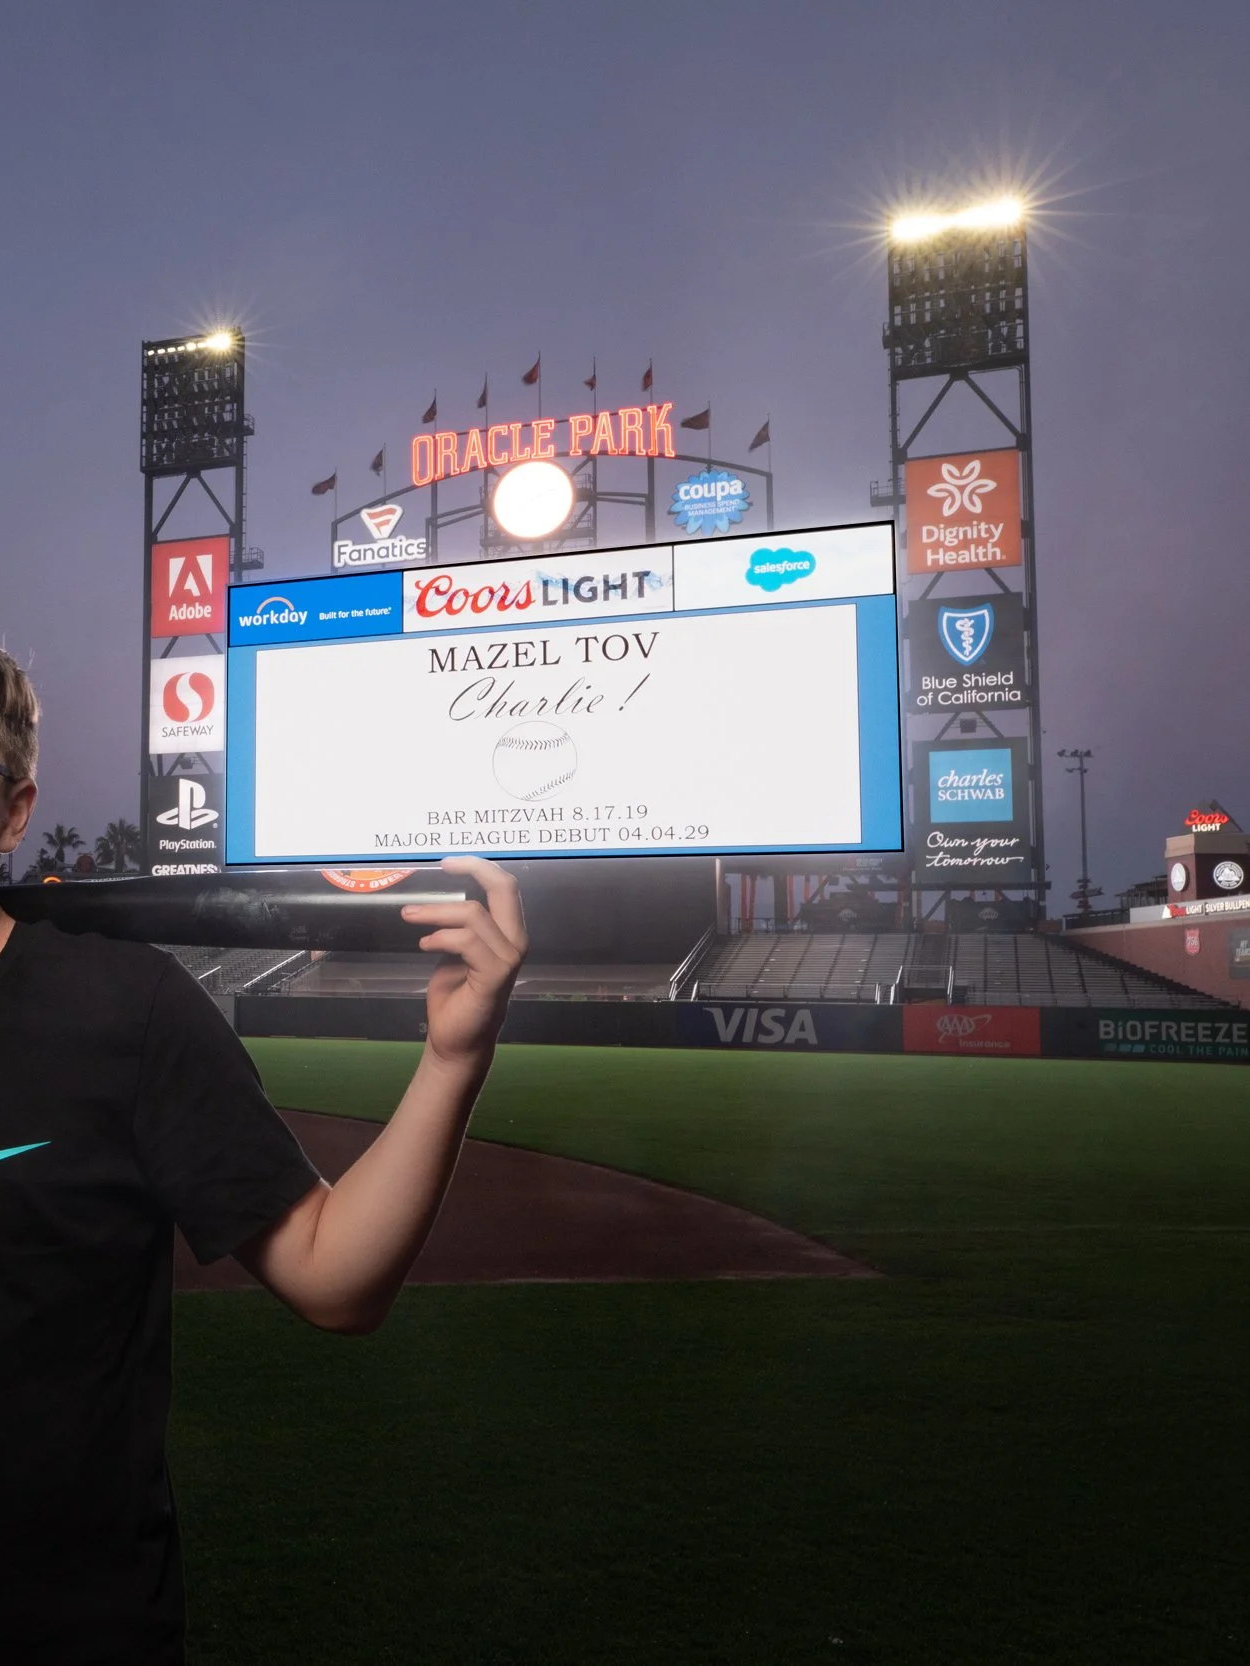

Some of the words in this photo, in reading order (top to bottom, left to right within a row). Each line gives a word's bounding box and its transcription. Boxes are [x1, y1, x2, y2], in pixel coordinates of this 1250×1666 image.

[412, 419, 555, 486] ORACLE
[569, 403, 676, 457] PARK
[679, 479, 743, 501] coupa
[685, 501, 716, 510] BUSINESS
[717, 499, 740, 507] SPEND
[688, 507, 736, 516] MANAGEMENT
[921, 521, 1004, 546] Dignity
[336, 538, 428, 564] Fanatics
[754, 560, 810, 574] salesforce
[414, 574, 536, 618] Coors
[542, 570, 651, 607] LIGHT
[169, 603, 212, 621] Adobe
[239, 608, 308, 627] workday
[319, 612, 337, 620] Built
[338, 610, 350, 619] for
[351, 609, 364, 617] the
[428, 640, 561, 673] MAZEL
[575, 631, 660, 663] TOV
[922, 676, 957, 690] Blue
[962, 671, 1014, 688] Shield
[916, 693, 934, 706] of
[938, 688, 1022, 706] California
[162, 724, 214, 738] SAFEWAY
[938, 768, 1004, 788] charles
[937, 787, 1005, 801] SCHWAB
[427, 811, 466, 825] BAR
[474, 807, 564, 824] MITZVAH
[572, 804, 648, 821] 8.17.19
[1184, 809, 1229, 825] Coors
[374, 831, 442, 848] MAJOR
[449, 829, 531, 846] LEAGUE
[538, 827, 611, 844] DEBUT
[618, 824, 710, 842] 04.04.29
[1192, 823, 1221, 832] LIGHT
[927, 831, 969, 848] Own
[970, 837, 1020, 856] your
[925, 851, 1025, 868] tomorrow
[1186, 904, 1203, 915] LIGHT
[1205, 902, 1225, 914] SILVER
[703, 1007, 818, 1045] VISA
[940, 1015, 974, 1036] AAA
[959, 1038, 1010, 1049] Insurance
[1150, 1044, 1182, 1054] COOL
[1190, 1045, 1213, 1056] THE
